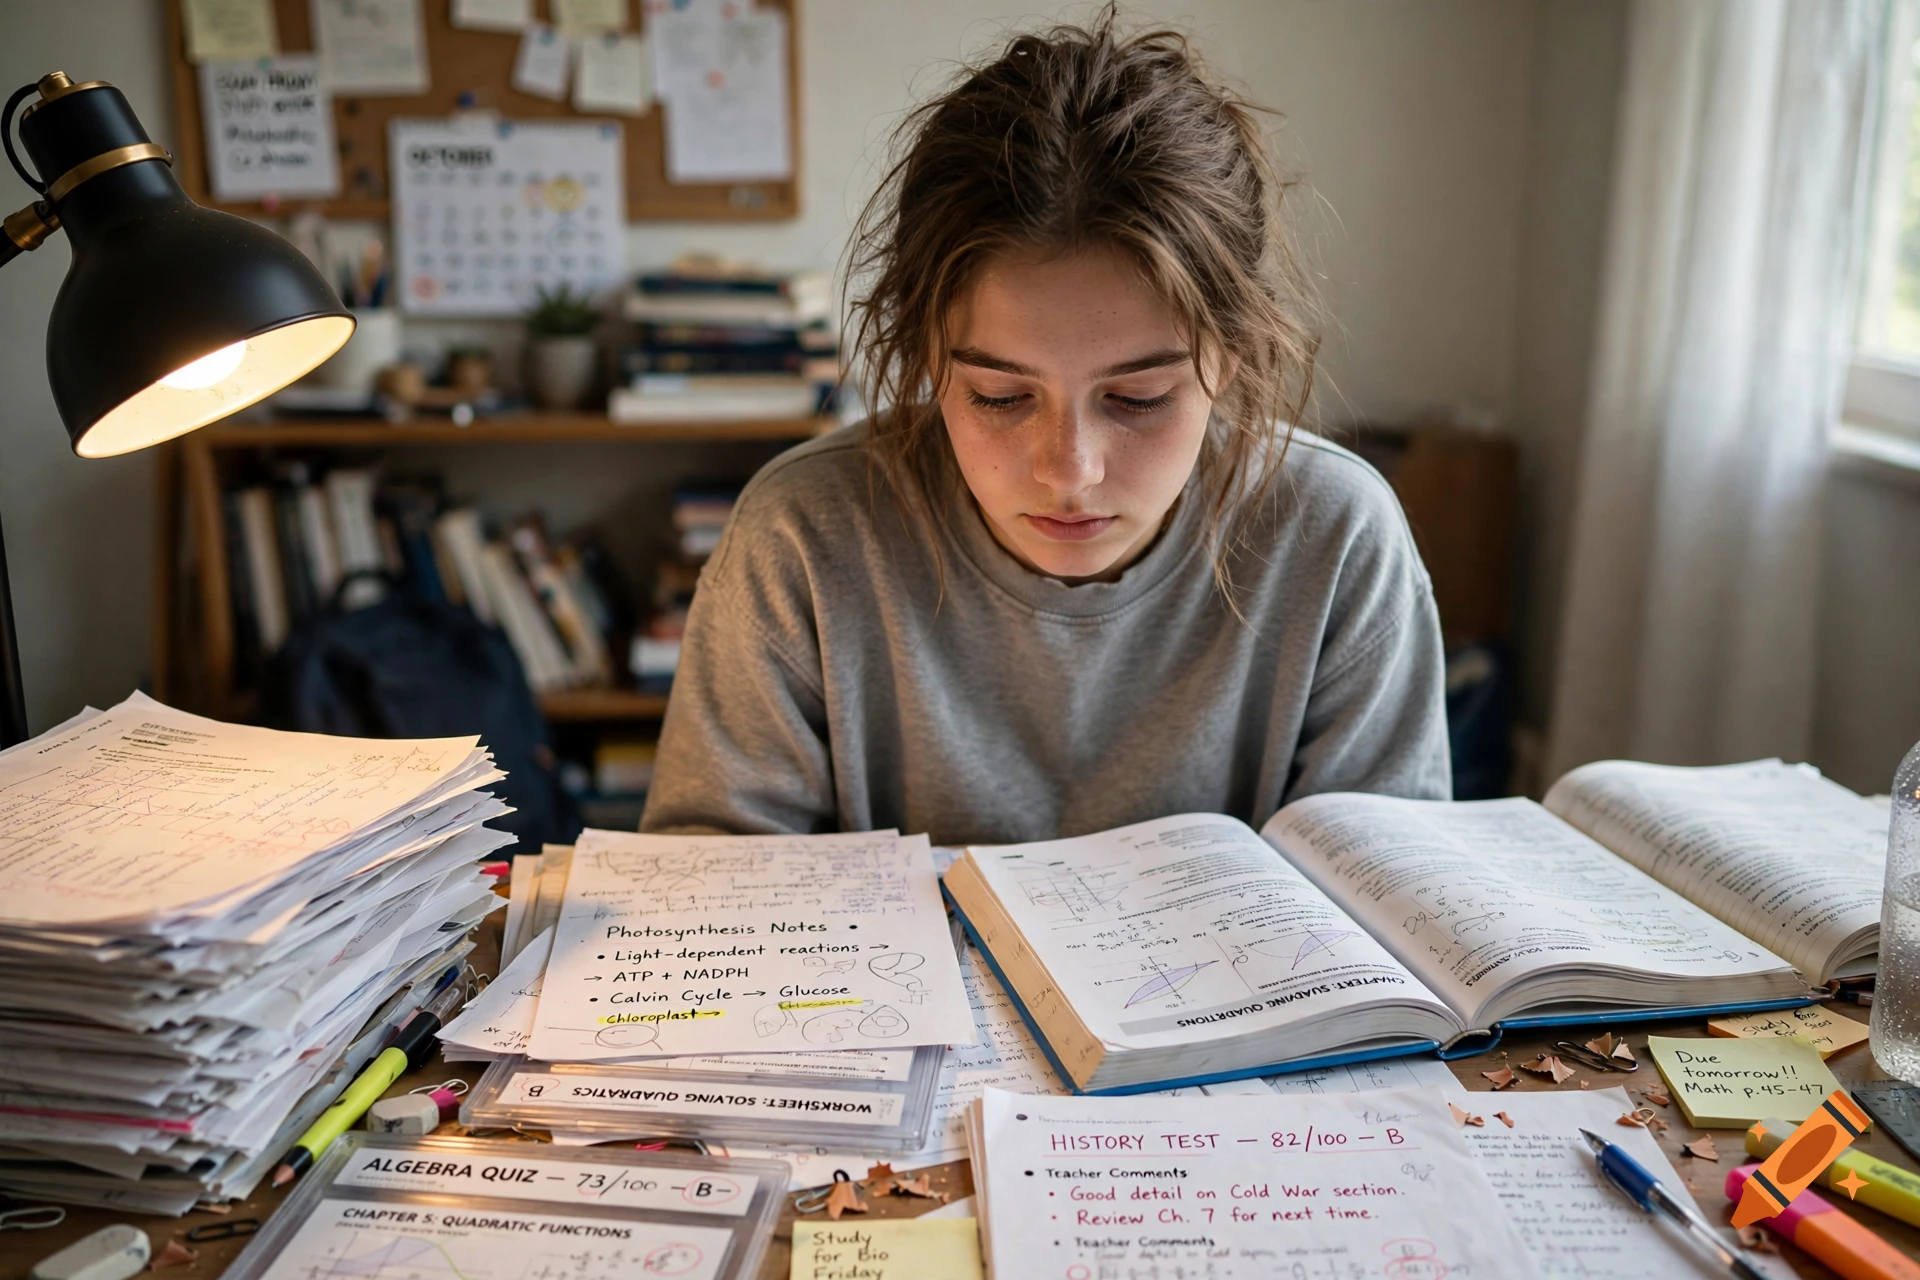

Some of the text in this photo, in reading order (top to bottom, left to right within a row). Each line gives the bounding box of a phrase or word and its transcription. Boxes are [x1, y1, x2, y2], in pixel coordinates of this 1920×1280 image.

[606, 921, 828, 942] Photosynthesis Notes
[615, 942, 860, 965] Light-dependent reactions
[613, 970, 654, 983] ATP
[683, 967, 749, 981] NADPH
[610, 984, 851, 1006] Calvin Cycle Glucose
[1675, 1050, 1722, 1064] Due
[1683, 1065, 1797, 1080] tomorrow!!
[528, 1085, 545, 1098] B
[1684, 1083, 1734, 1095] Math
[572, 1087, 872, 1114] WORKSHEET: SOLVING QUADRATICS
[1051, 1133, 1144, 1151] HISTORY
[1160, 1133, 1221, 1149] TEST
[1271, 1126, 1347, 1152] 82/100
[1386, 1128, 1405, 1145] B
[362, 1157, 473, 1178] ALGEBRA
[481, 1165, 538, 1183] QUIZ
[576, 1169, 658, 1198] 73/100
[1045, 1167, 1188, 1179] Teacher Comments
[1070, 1183, 1405, 1201] Good detail on Cold War section.
[342, 1207, 418, 1223] CHAPTER
[421, 1213, 438, 1224] 5:
[442, 1214, 536, 1233] QUADRATIC
[538, 1223, 632, 1240] FUNCTIONS
[1076, 1206, 1380, 1225] Review Ch. 7 for next time.
[812, 1230, 872, 1250] Study
[813, 1249, 889, 1264] for Bio
[813, 1264, 884, 1280] Friday
